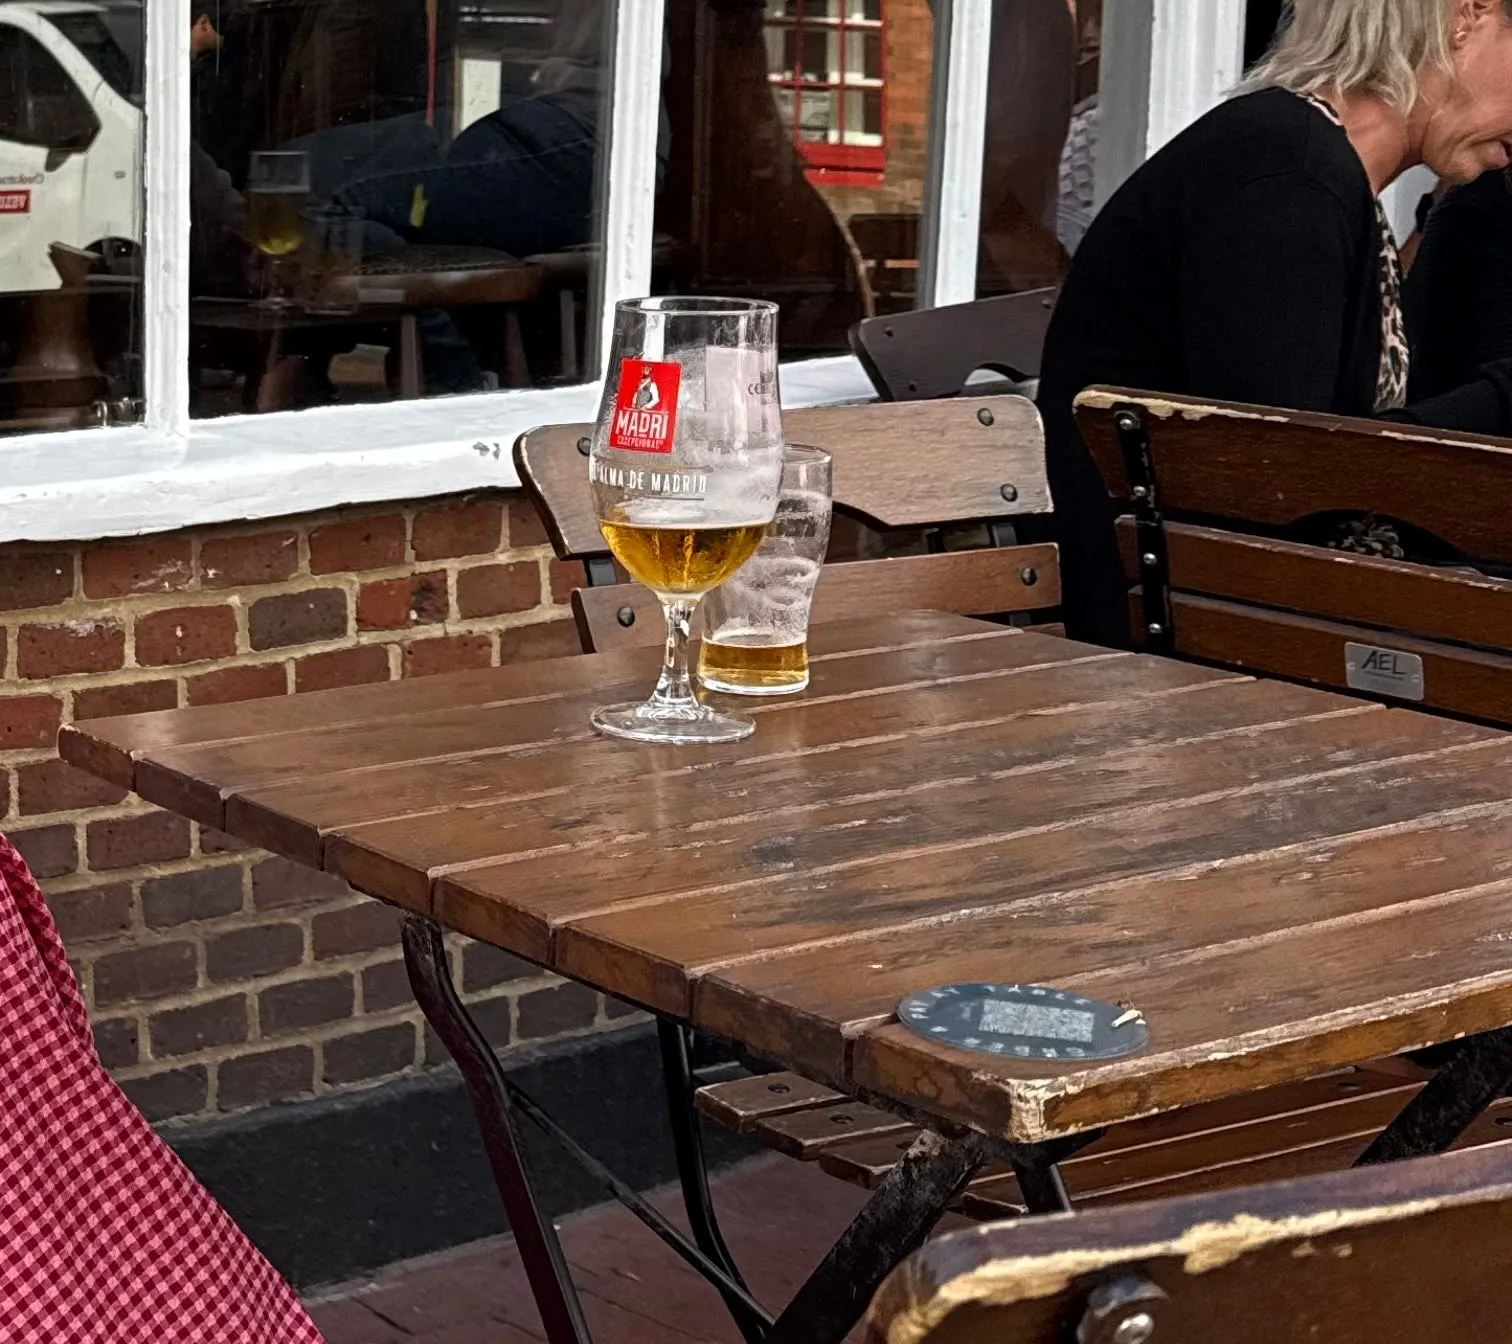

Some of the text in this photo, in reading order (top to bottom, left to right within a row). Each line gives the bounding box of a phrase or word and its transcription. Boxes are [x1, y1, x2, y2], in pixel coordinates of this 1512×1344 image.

[599, 465, 624, 487] ALMA
[629, 469, 645, 490] DE
[651, 472, 707, 493] MADRID
[1361, 649, 1408, 675] AEL
